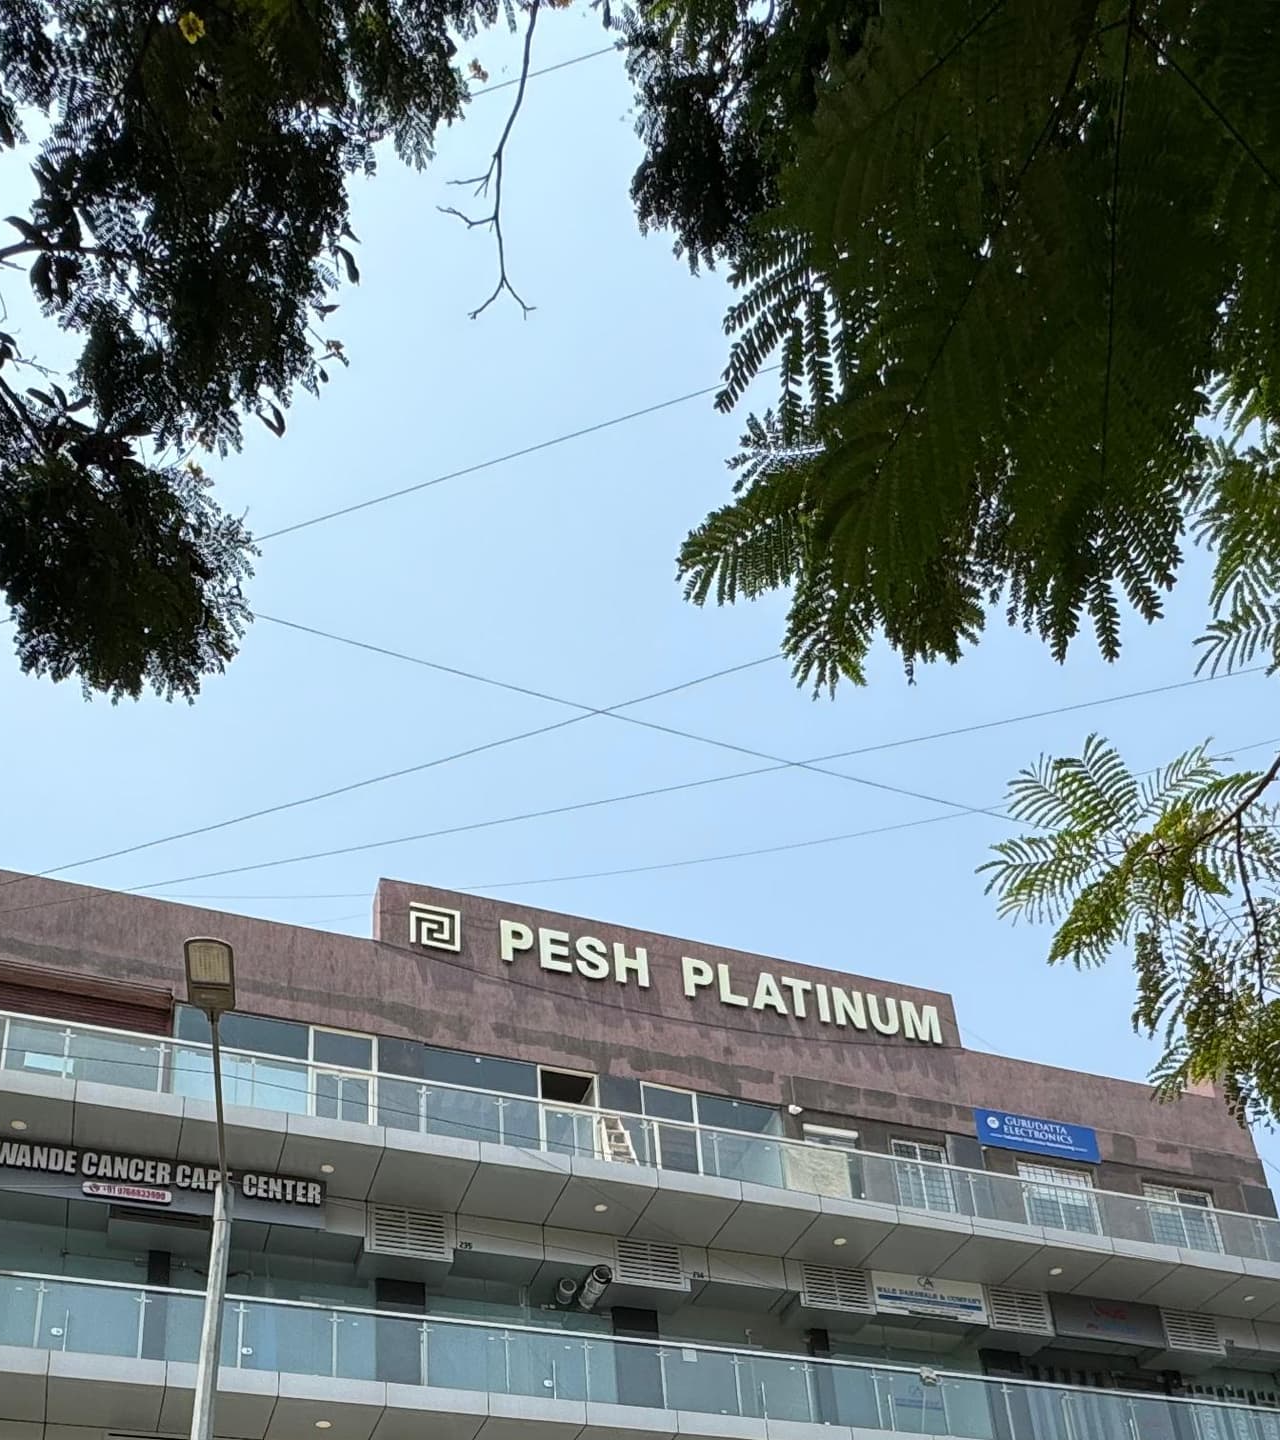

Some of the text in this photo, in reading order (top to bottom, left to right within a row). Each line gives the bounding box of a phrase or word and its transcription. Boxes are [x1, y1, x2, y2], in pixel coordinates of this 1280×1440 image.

[499, 919, 944, 1046] PESH PLATINUM
[1004, 1116, 1067, 1134] GURUDATTA
[1004, 1126, 1073, 1145] ELECTRONICS
[81, 1152, 171, 1185] CANCER
[242, 1173, 321, 1204] CENTER
